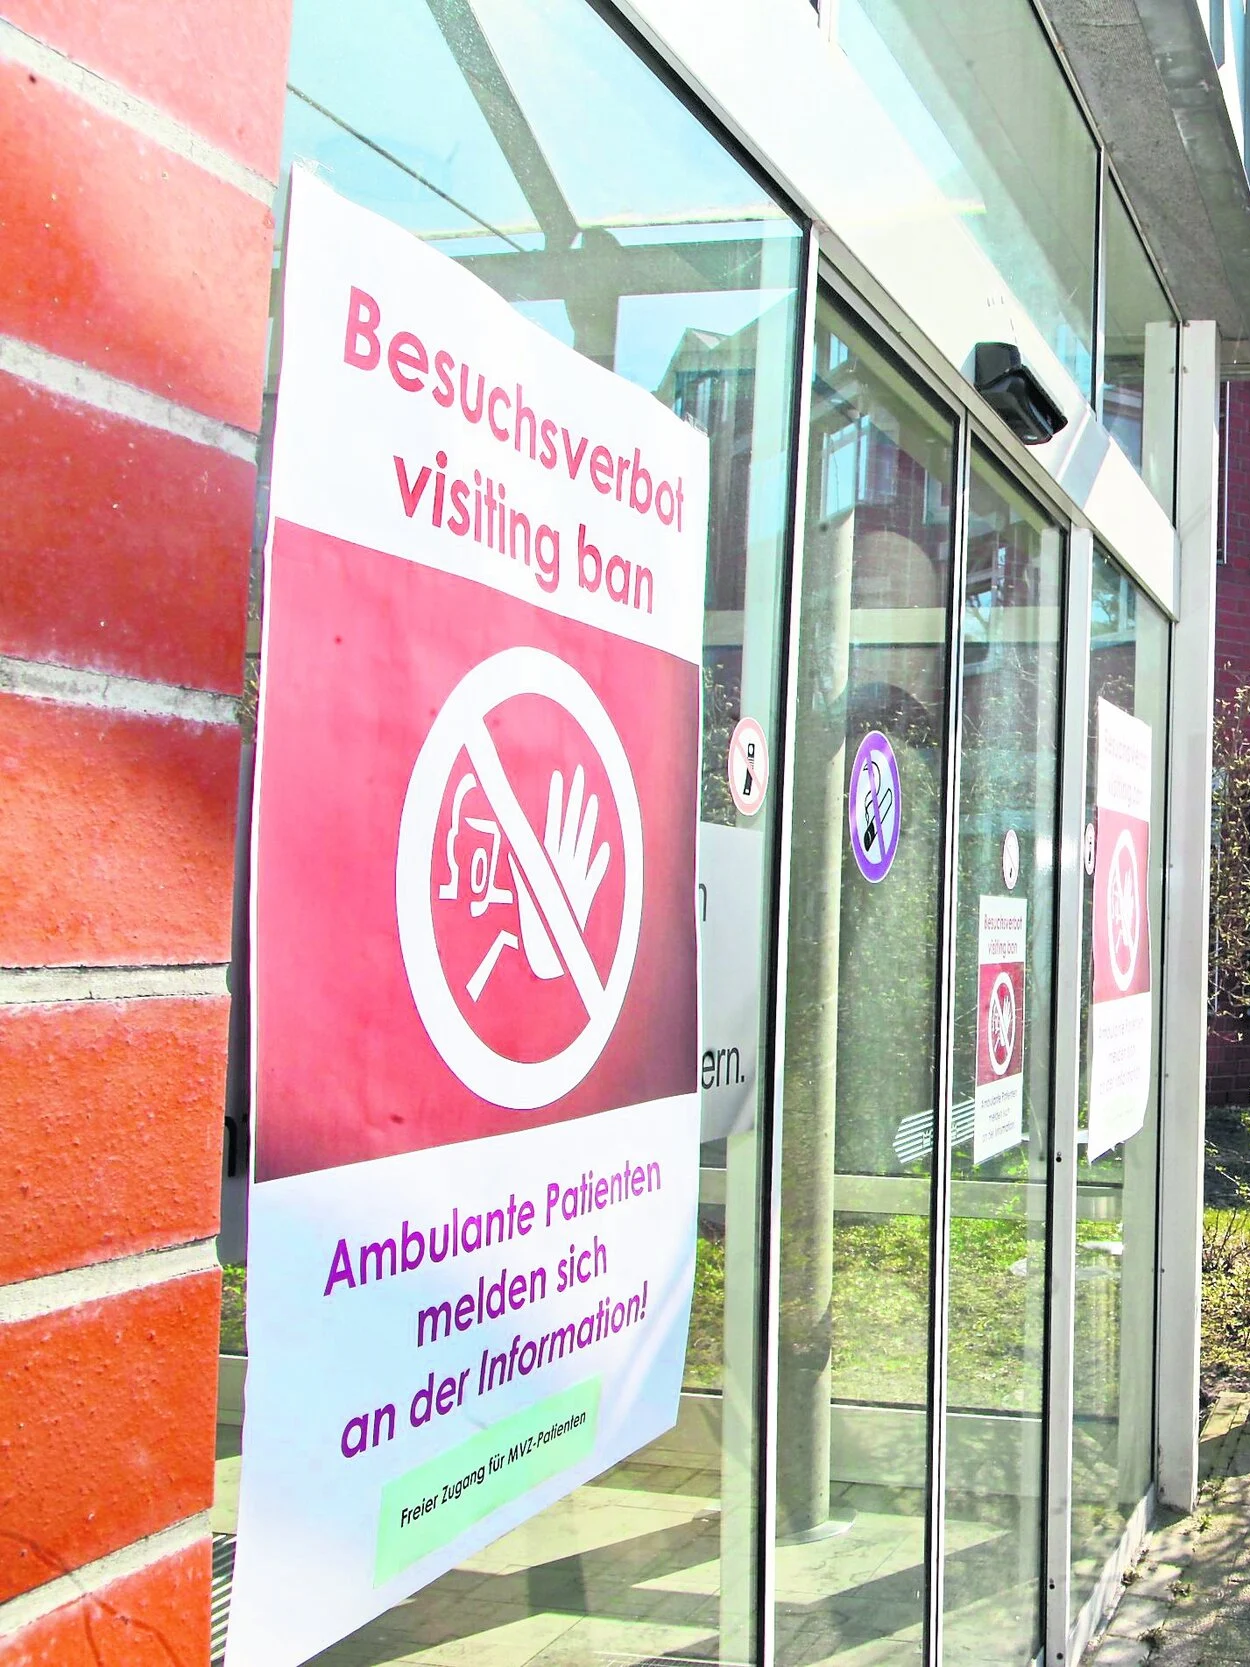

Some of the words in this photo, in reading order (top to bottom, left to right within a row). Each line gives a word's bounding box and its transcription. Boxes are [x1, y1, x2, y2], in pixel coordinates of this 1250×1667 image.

[344, 286, 684, 532] Besuchsverbot
[393, 451, 560, 593] visiting
[578, 523, 654, 614] ban
[701, 1046, 745, 1090] ern.
[323, 1194, 534, 1297] Ambulante
[546, 1159, 662, 1228] Patienten
[417, 1265, 546, 1347] melden
[556, 1236, 607, 1293] sich
[341, 1404, 395, 1459] an
[410, 1368, 470, 1428] der
[478, 1280, 648, 1396] Information!
[401, 1493, 438, 1528] Freier
[441, 1466, 485, 1506] Zugang
[488, 1452, 504, 1478] für
[507, 1409, 587, 1462] MVZ-Patienten
